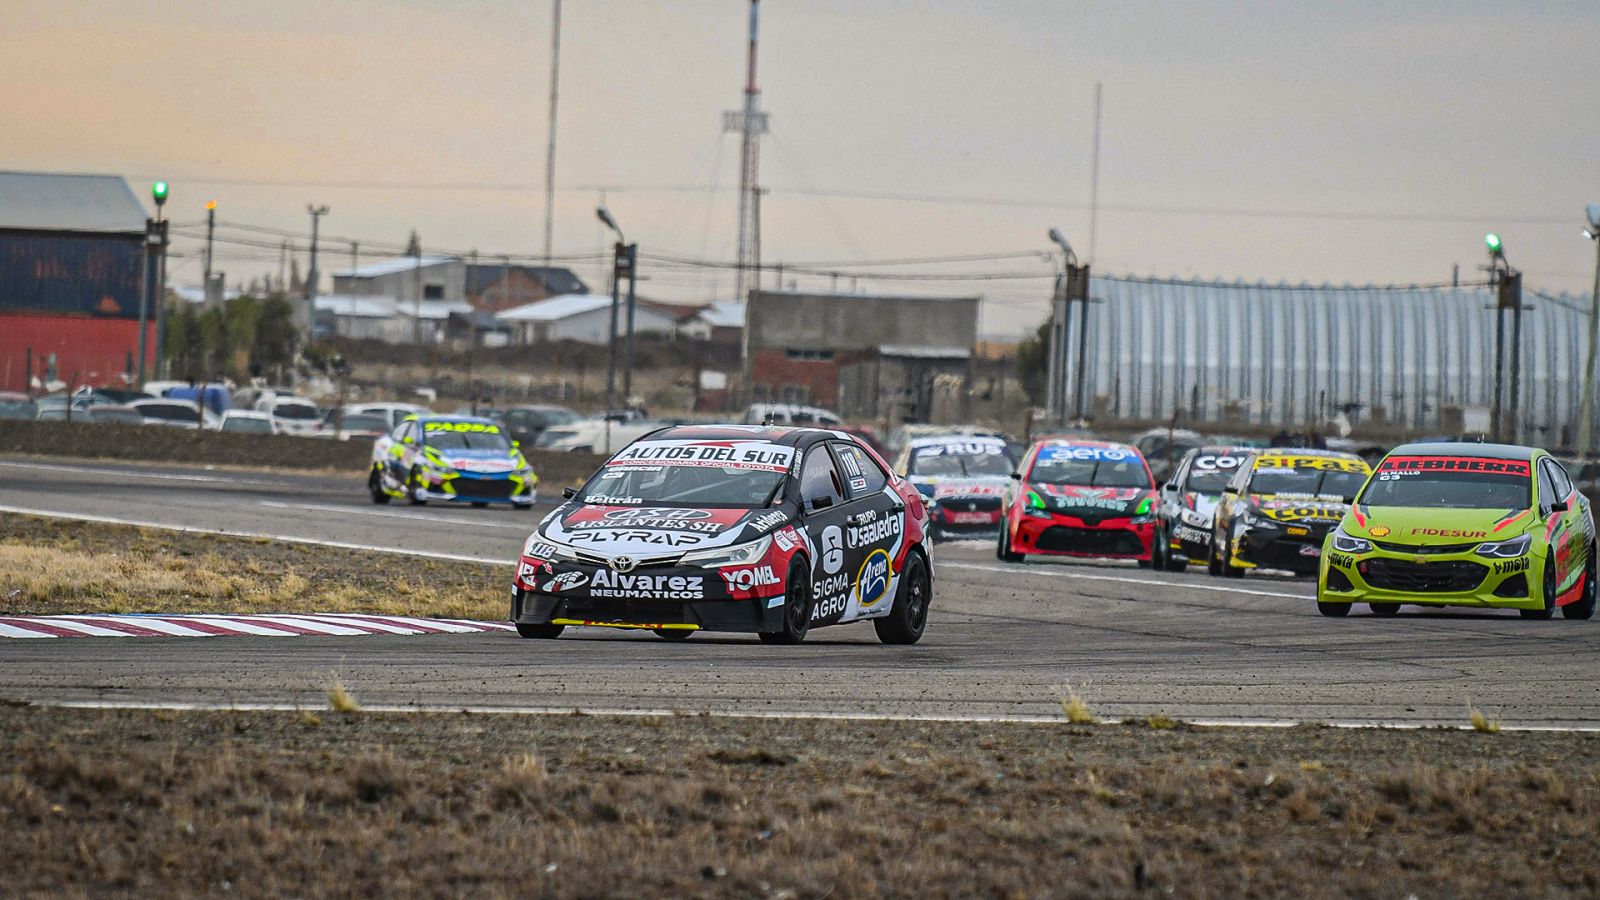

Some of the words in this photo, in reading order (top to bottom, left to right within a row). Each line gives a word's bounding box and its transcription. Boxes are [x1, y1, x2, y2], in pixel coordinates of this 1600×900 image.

[620, 447, 698, 459] AUTOS
[698, 447, 737, 462] DEL
[742, 450, 788, 466] SUR
[739, 463, 776, 471] TOYOTA
[1383, 460, 1527, 473] LIEBHERR
[584, 495, 643, 504] Beltrán
[571, 518, 690, 530] AISLANTES
[690, 521, 724, 532] SH
[1411, 528, 1488, 538] FIDESUR
[568, 531, 702, 547] PLYRAP
[530, 542, 558, 560] 118
[590, 569, 704, 591] Alvarez
[722, 564, 781, 592] YOMEL
[812, 571, 849, 600] SIGMA
[590, 589, 704, 599] NEUMATICOS
[811, 593, 846, 621] AGRO
